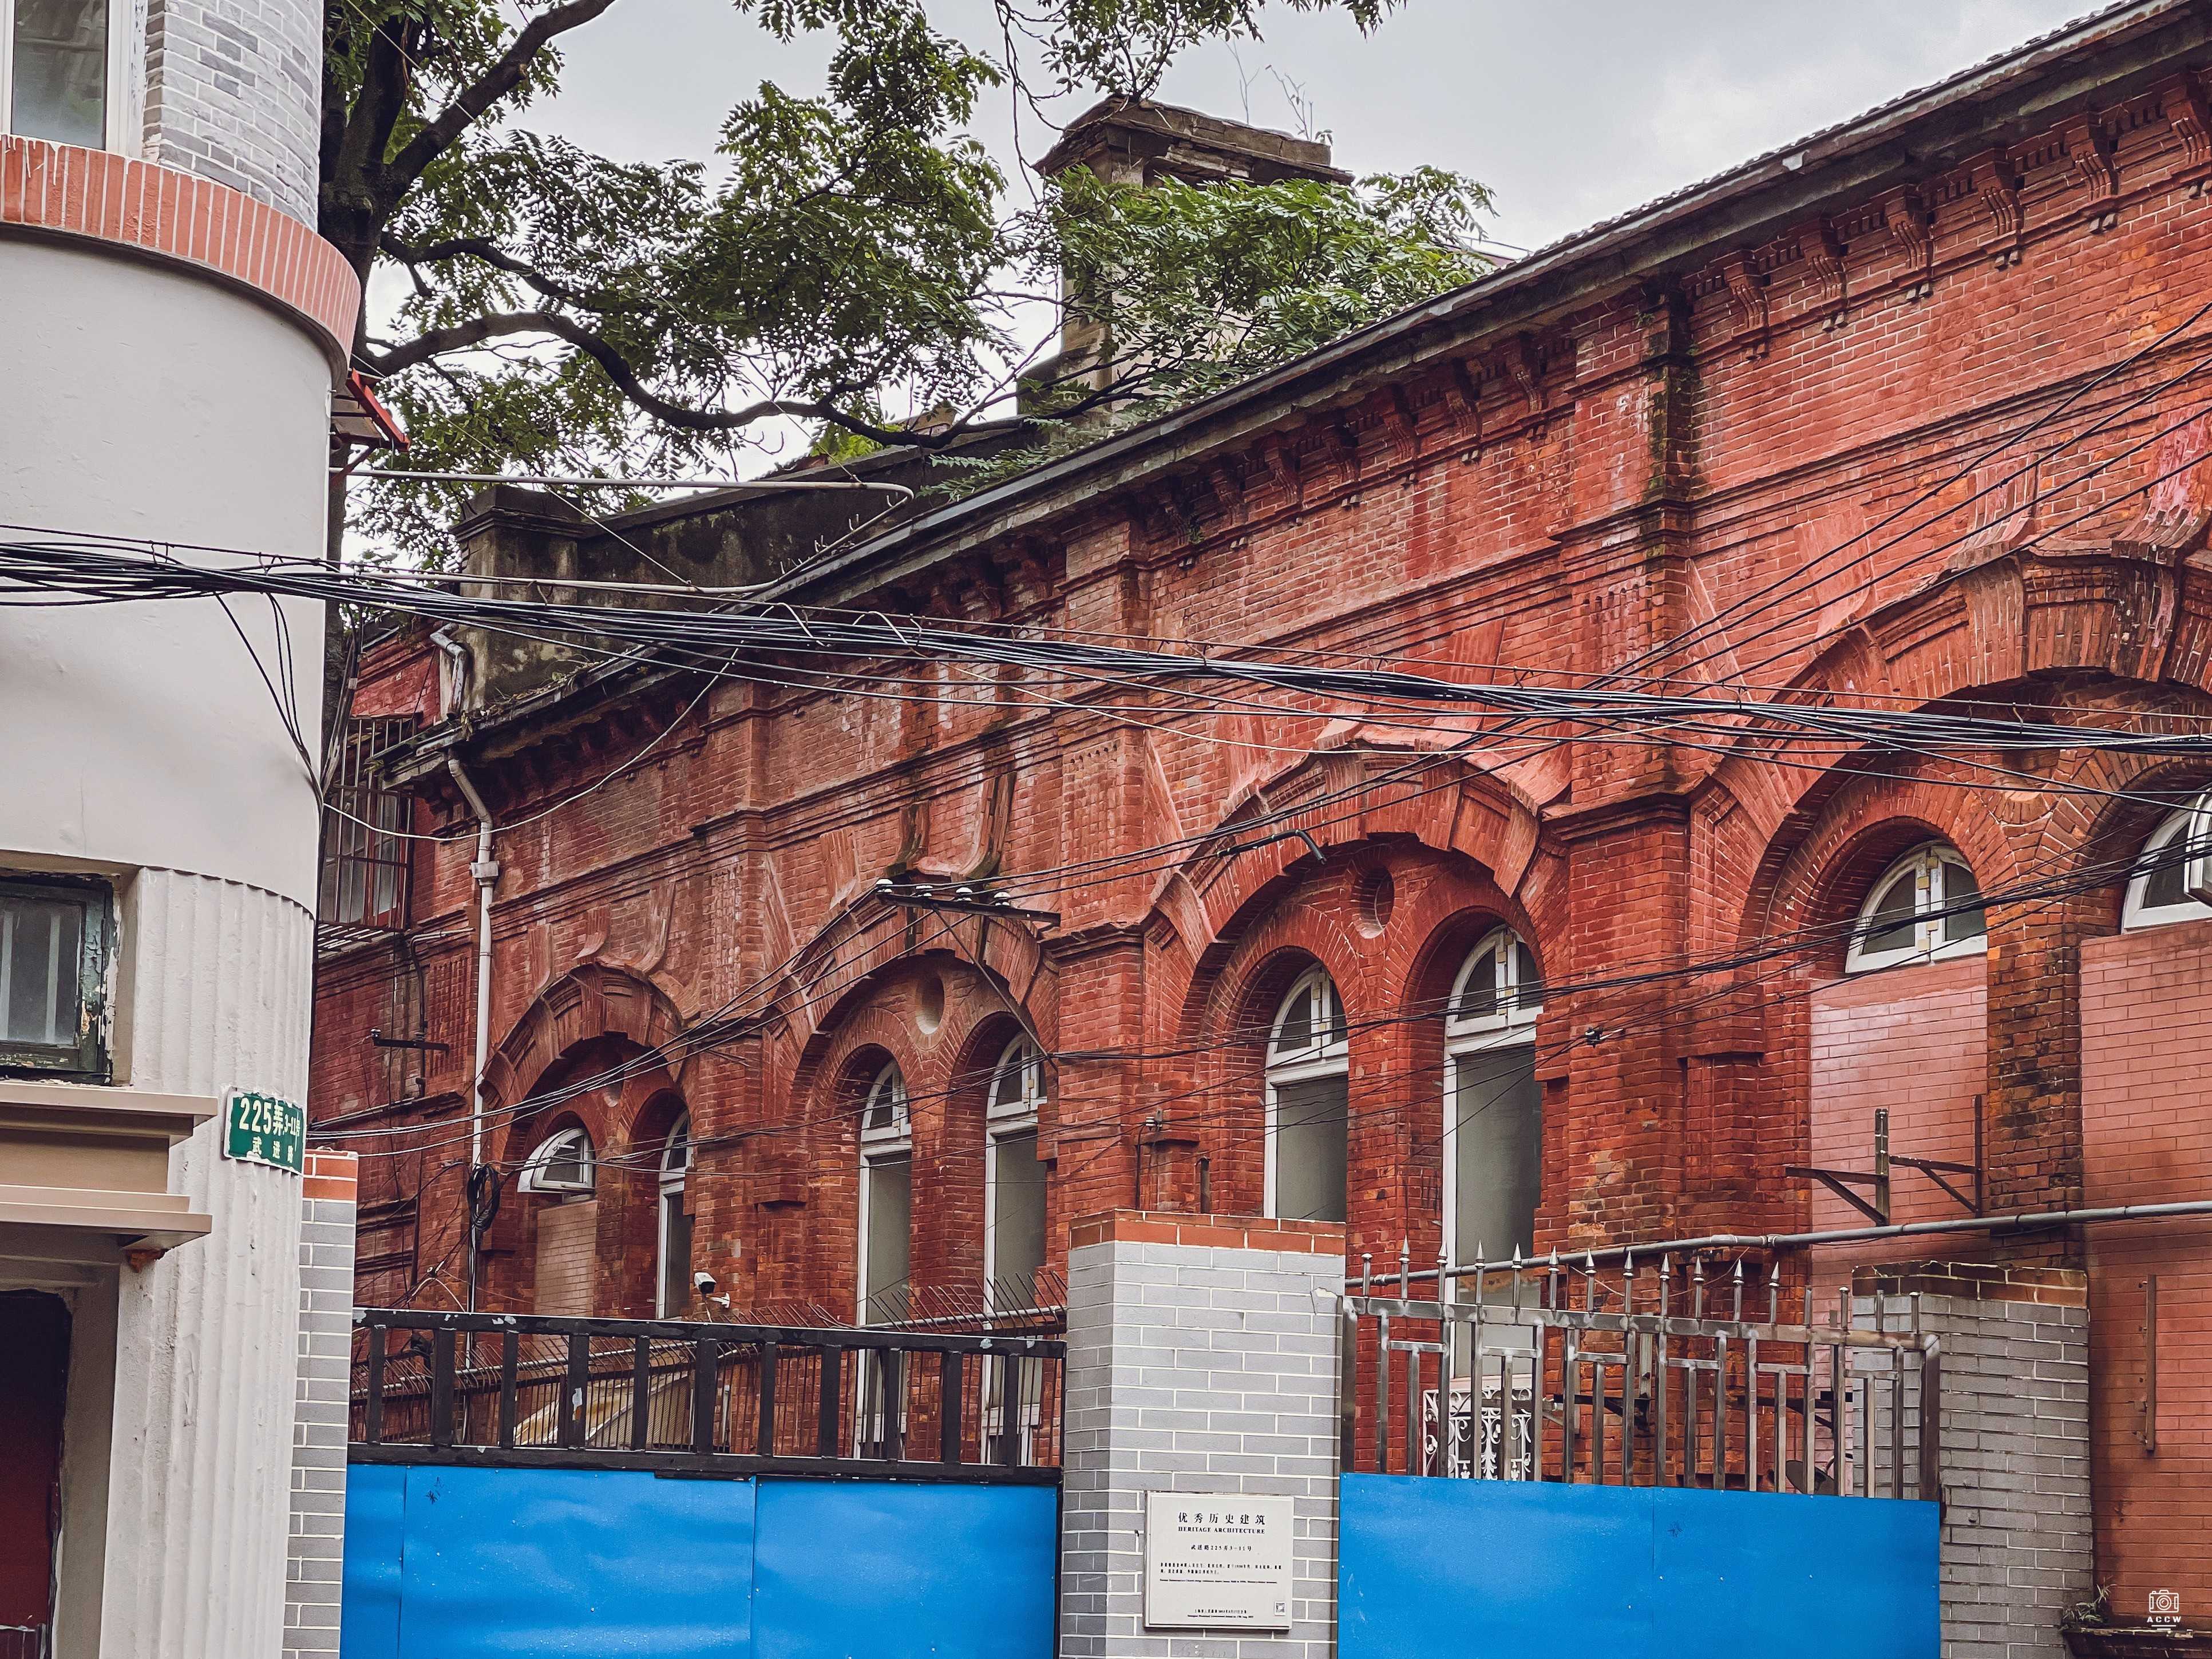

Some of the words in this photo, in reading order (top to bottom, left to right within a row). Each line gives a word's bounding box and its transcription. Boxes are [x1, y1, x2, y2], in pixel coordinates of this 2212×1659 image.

[252, 1136, 294, 1163] 武进路
[1178, 1511, 1266, 1525] 优秀历史建筑
